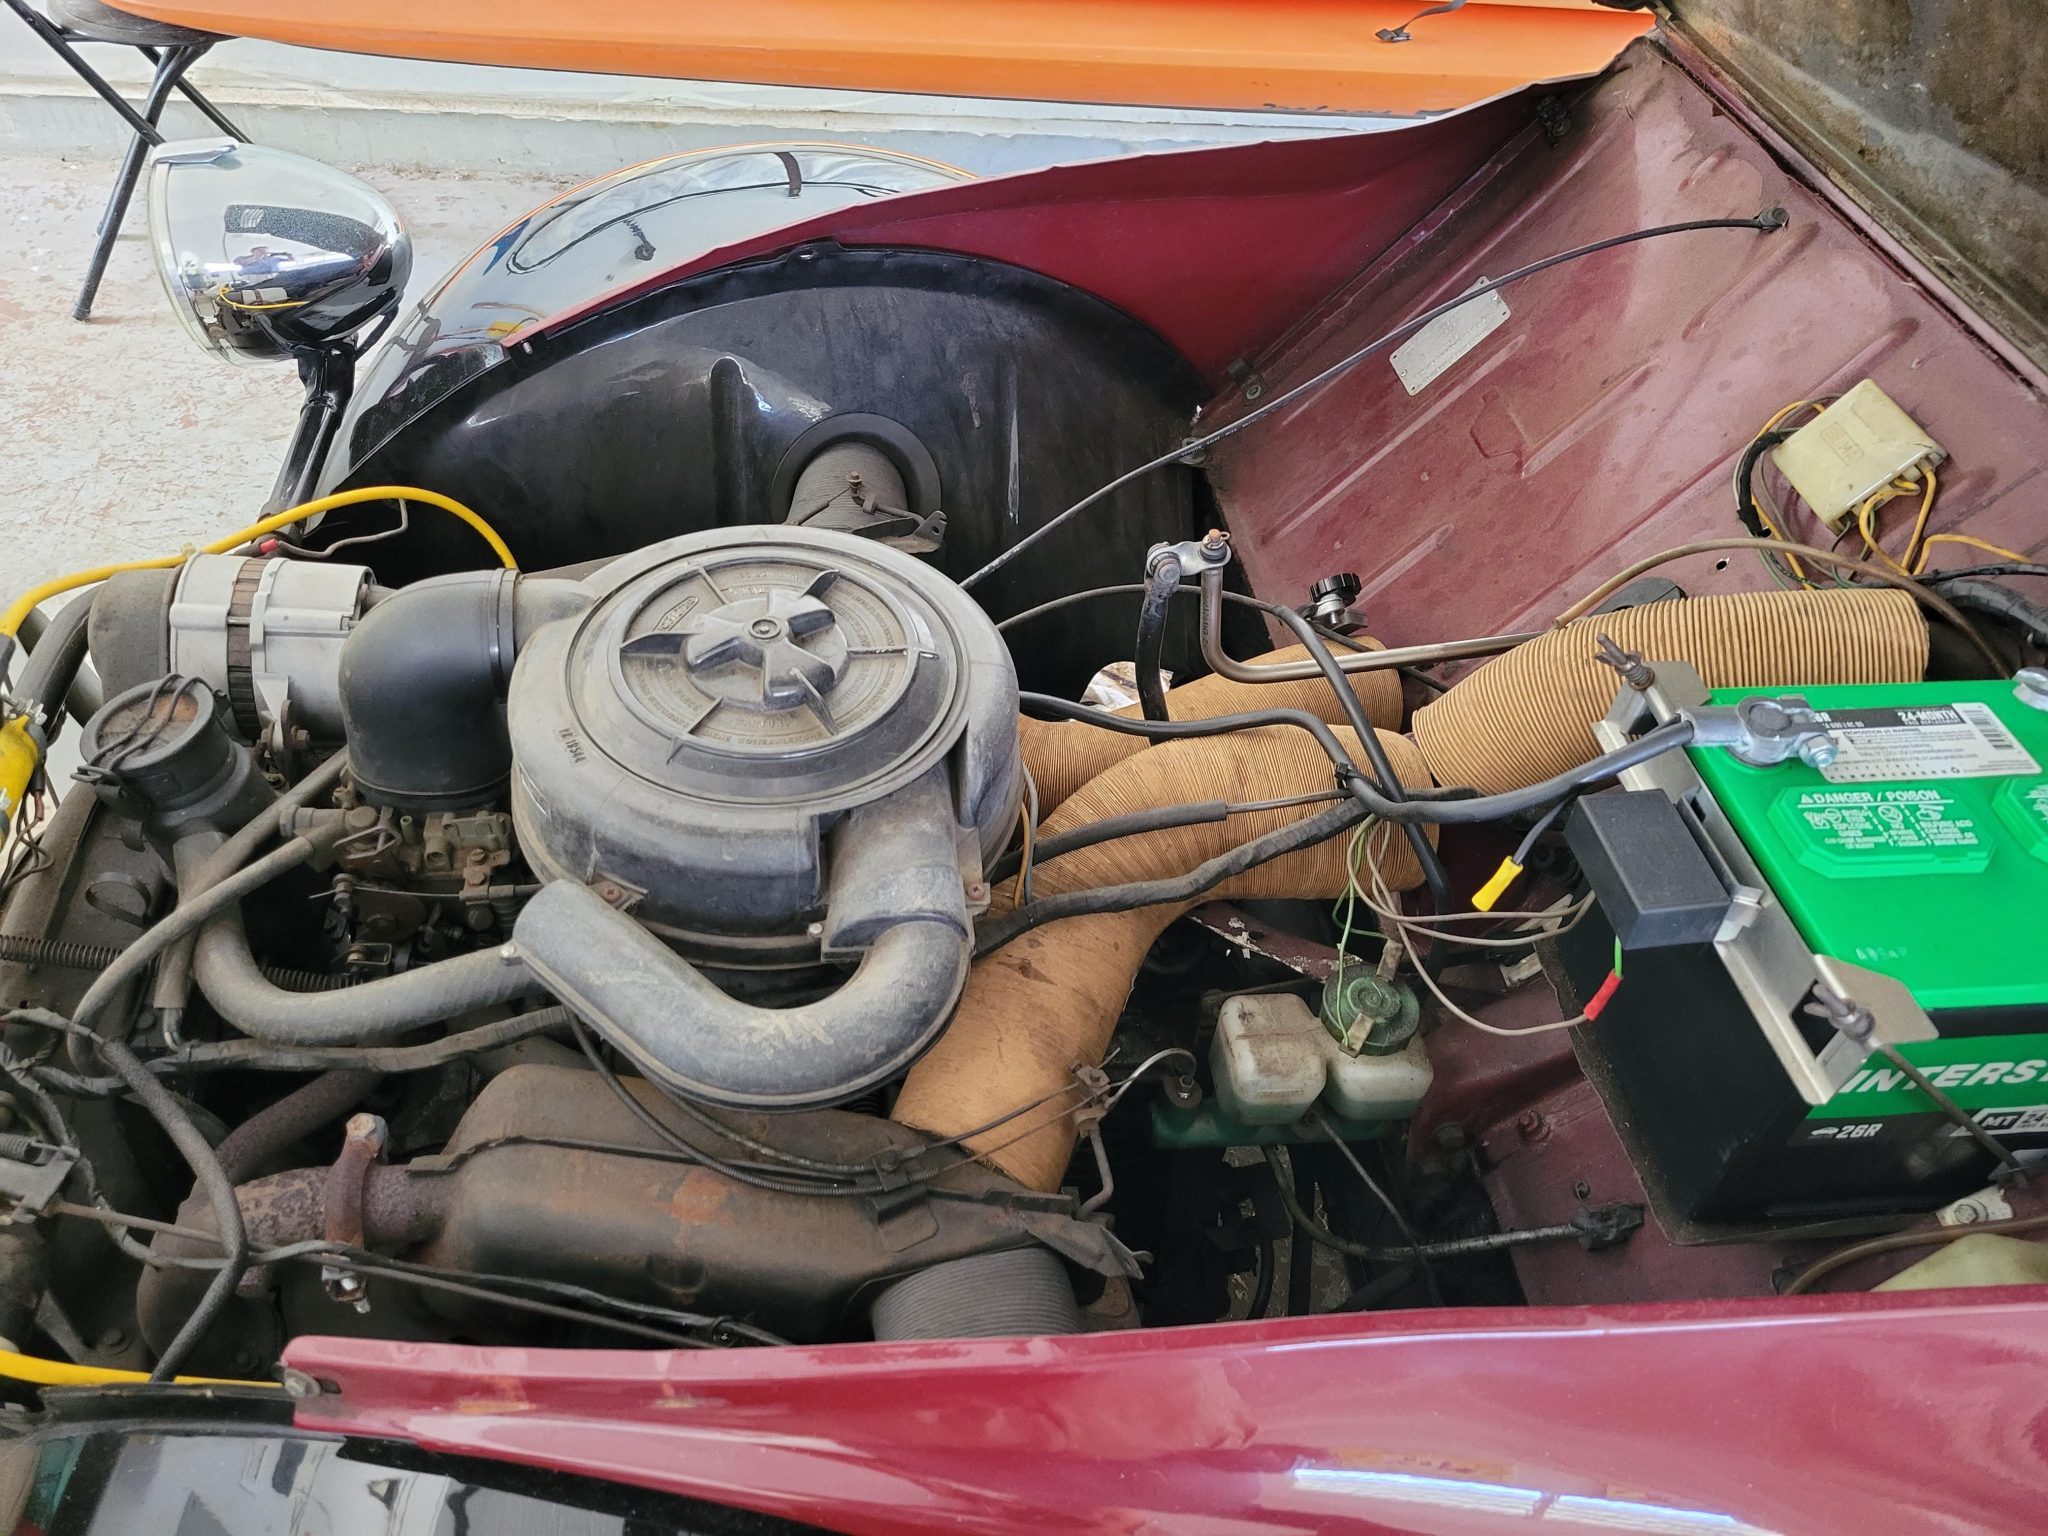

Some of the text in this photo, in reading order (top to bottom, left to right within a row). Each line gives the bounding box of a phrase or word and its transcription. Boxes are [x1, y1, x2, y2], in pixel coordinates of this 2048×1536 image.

[1898, 709, 1960, 721] 24-MONTH
[1813, 792, 1874, 804] DANGER
[1885, 790, 1941, 801] POISON
[1981, 1115, 2019, 1127] MT
[1835, 1123, 1883, 1139] 26R
